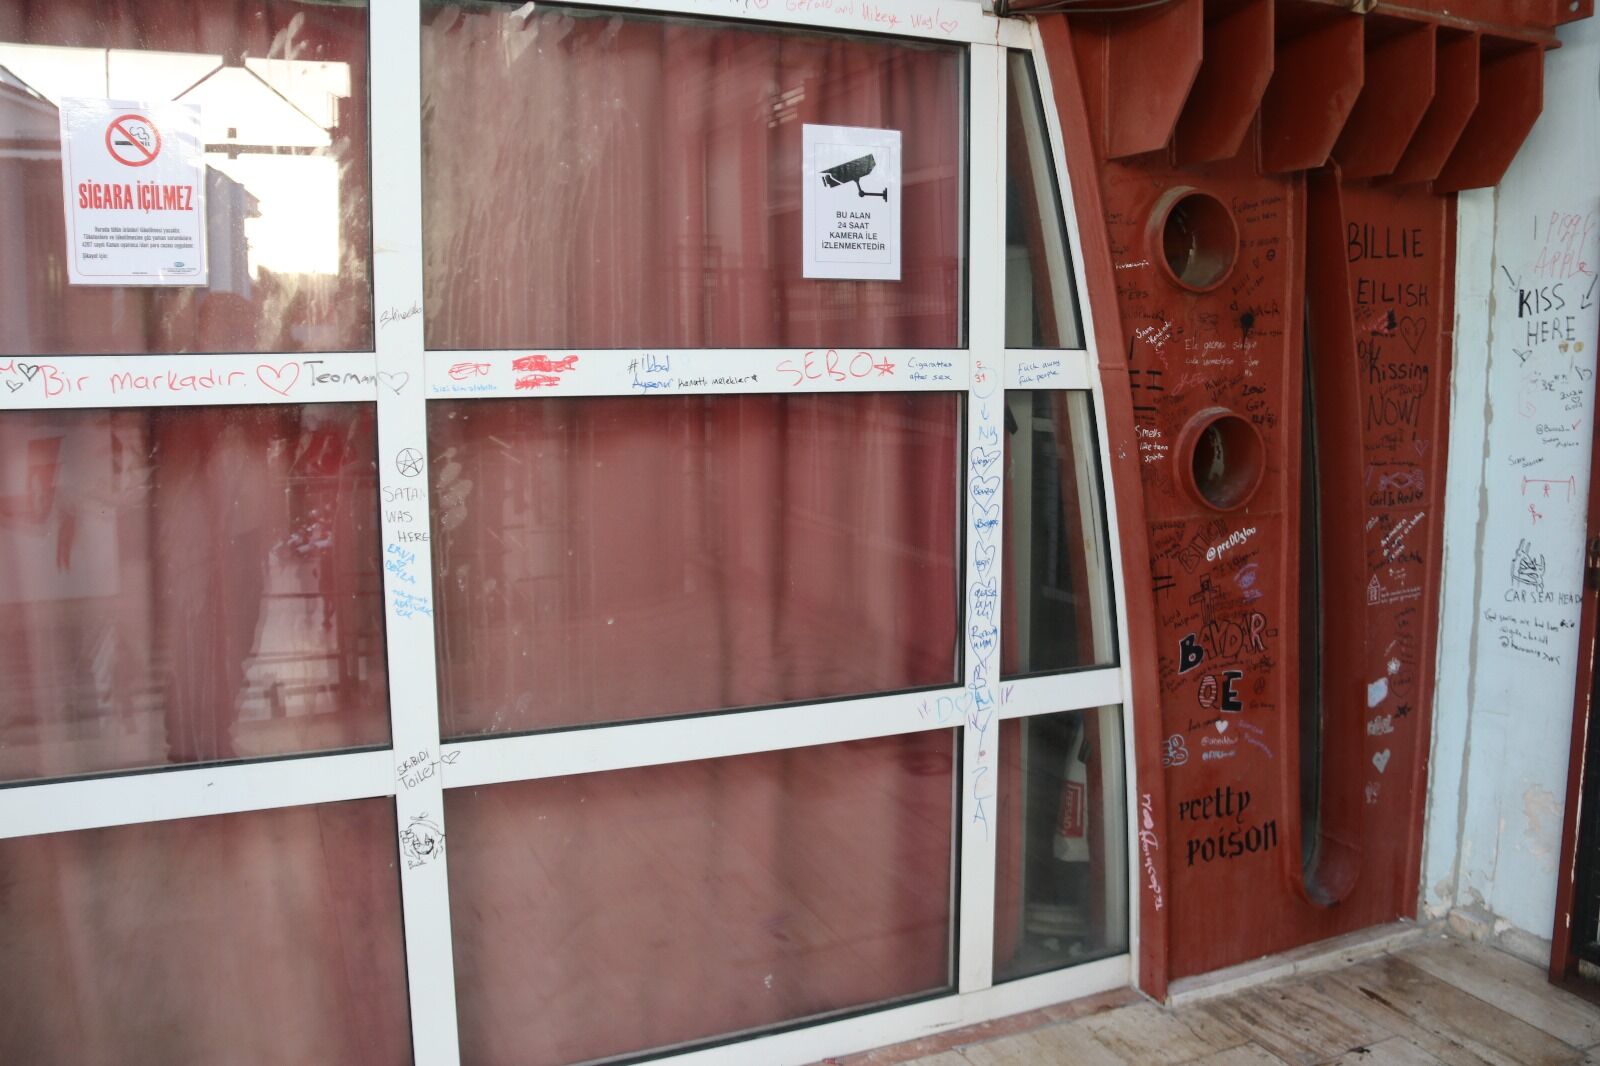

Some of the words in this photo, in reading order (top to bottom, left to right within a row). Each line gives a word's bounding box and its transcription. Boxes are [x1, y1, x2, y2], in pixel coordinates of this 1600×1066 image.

[78, 179, 134, 210] SİGARA
[137, 180, 193, 214] İÇİLMEZ
[836, 211, 847, 219] BU
[848, 221, 869, 229] SAAT
[821, 240, 885, 251] İZLENMEKTEDİR
[829, 231, 863, 239] KAMERA
[865, 232, 878, 240] İLE
[1347, 222, 1425, 263] BILLIE
[1356, 278, 1429, 308] EILISH
[1518, 283, 1566, 319] KISS
[1527, 315, 1576, 347] HERE
[37, 365, 90, 398] Bir
[303, 361, 378, 387] Teoman
[931, 373, 953, 381] sex
[385, 510, 413, 523] WAS
[397, 529, 431, 543] HERE
[1504, 588, 1526, 602] CAR
[1531, 591, 1554, 603] SEAT
[1558, 592, 1581, 605] HEAD
[1187, 819, 1277, 868] poison
